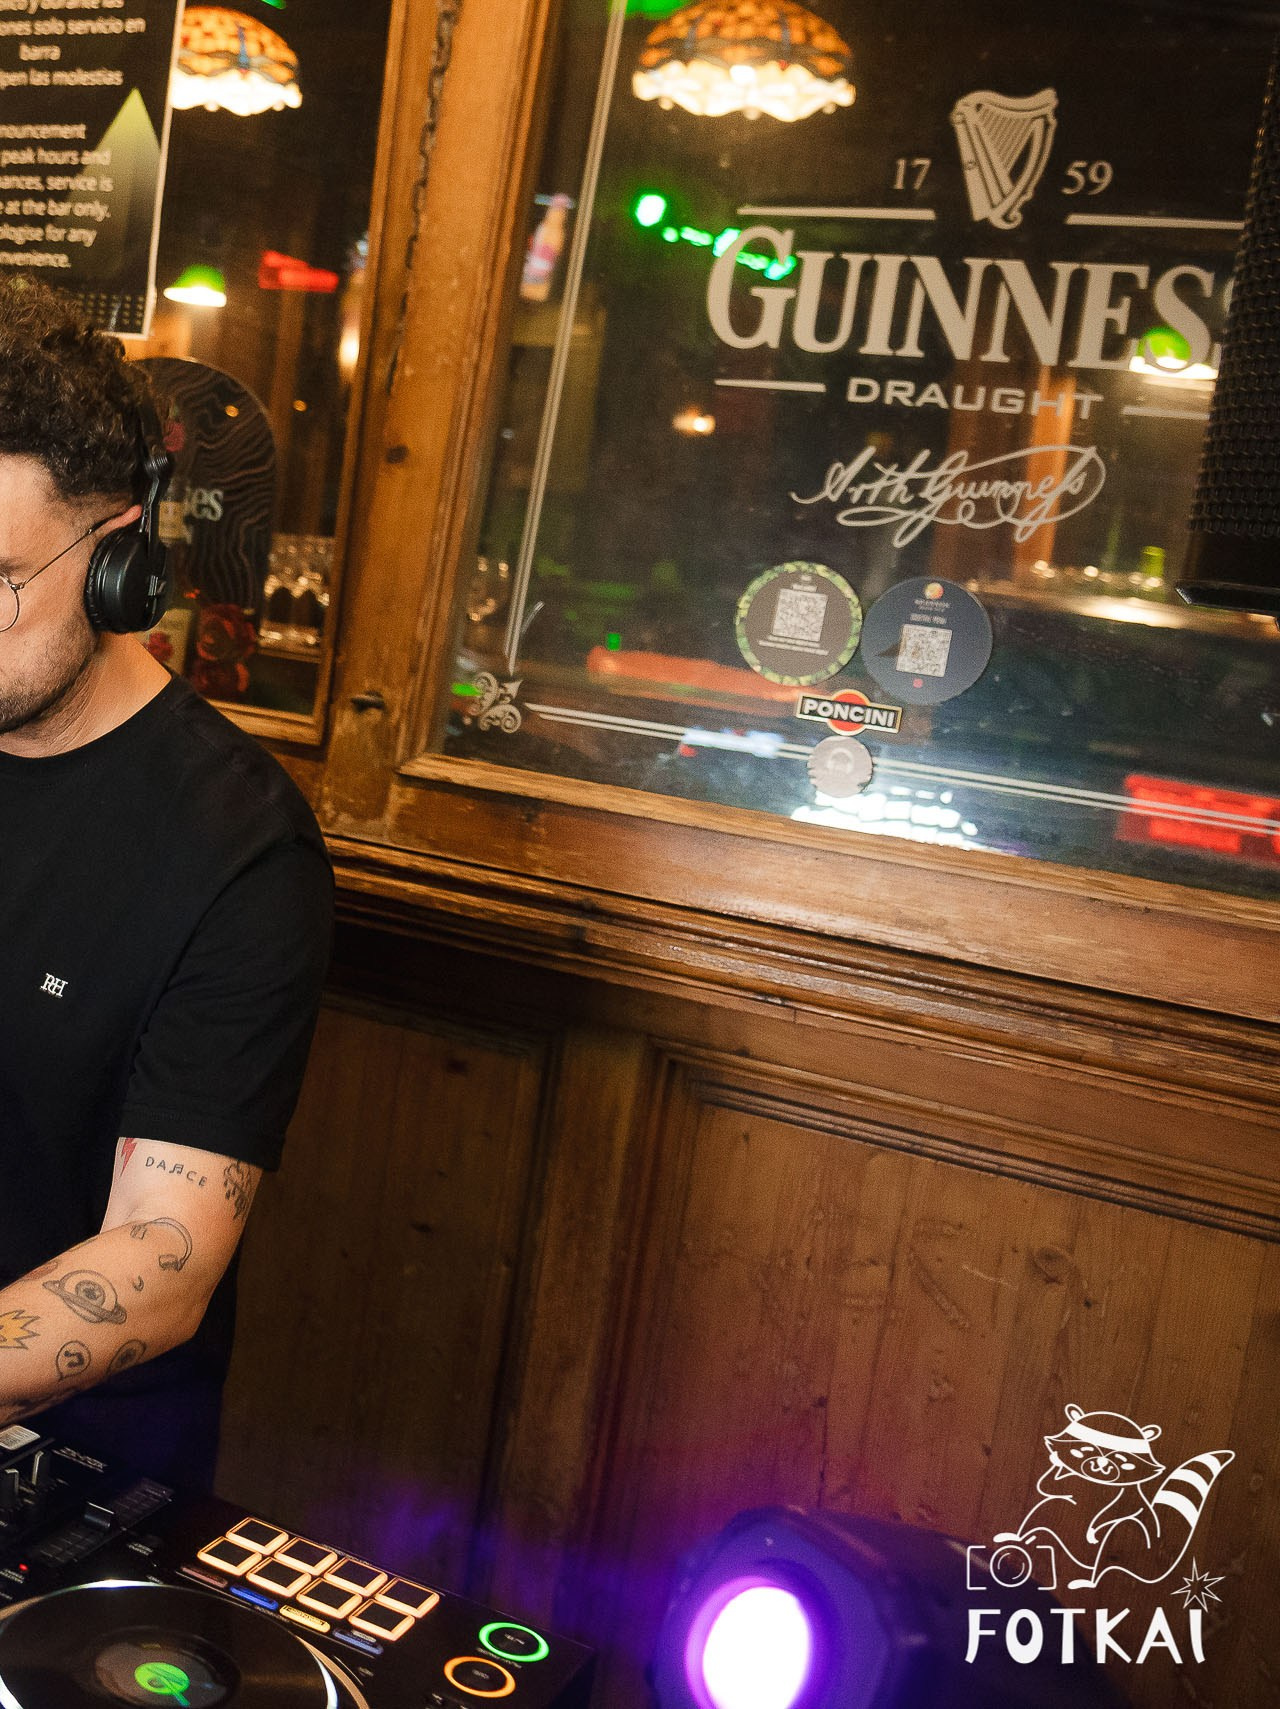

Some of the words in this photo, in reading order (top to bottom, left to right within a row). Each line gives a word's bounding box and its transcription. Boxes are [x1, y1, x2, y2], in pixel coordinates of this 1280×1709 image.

[66, 16, 124, 35] servicio
[125, 17, 146, 33] en
[19, 43, 61, 61] barra
[29, 67, 50, 86] las
[51, 67, 124, 86] molestias
[1, 147, 35, 168] peak
[36, 146, 79, 165] hours
[80, 149, 112, 166] and
[46, 174, 98, 191] service
[99, 175, 114, 192] is
[893, 157, 933, 191] 17
[1062, 159, 1114, 196] 59
[5, 199, 21, 215] at
[22, 198, 46, 216] the
[47, 199, 72, 217] bar
[73, 200, 112, 222] only.
[45, 223, 67, 242] for
[67, 228, 98, 248] any
[705, 225, 1234, 373] GUINNES
[847, 377, 1105, 421] DRAUGHT
[803, 698, 896, 729] PONCINI
